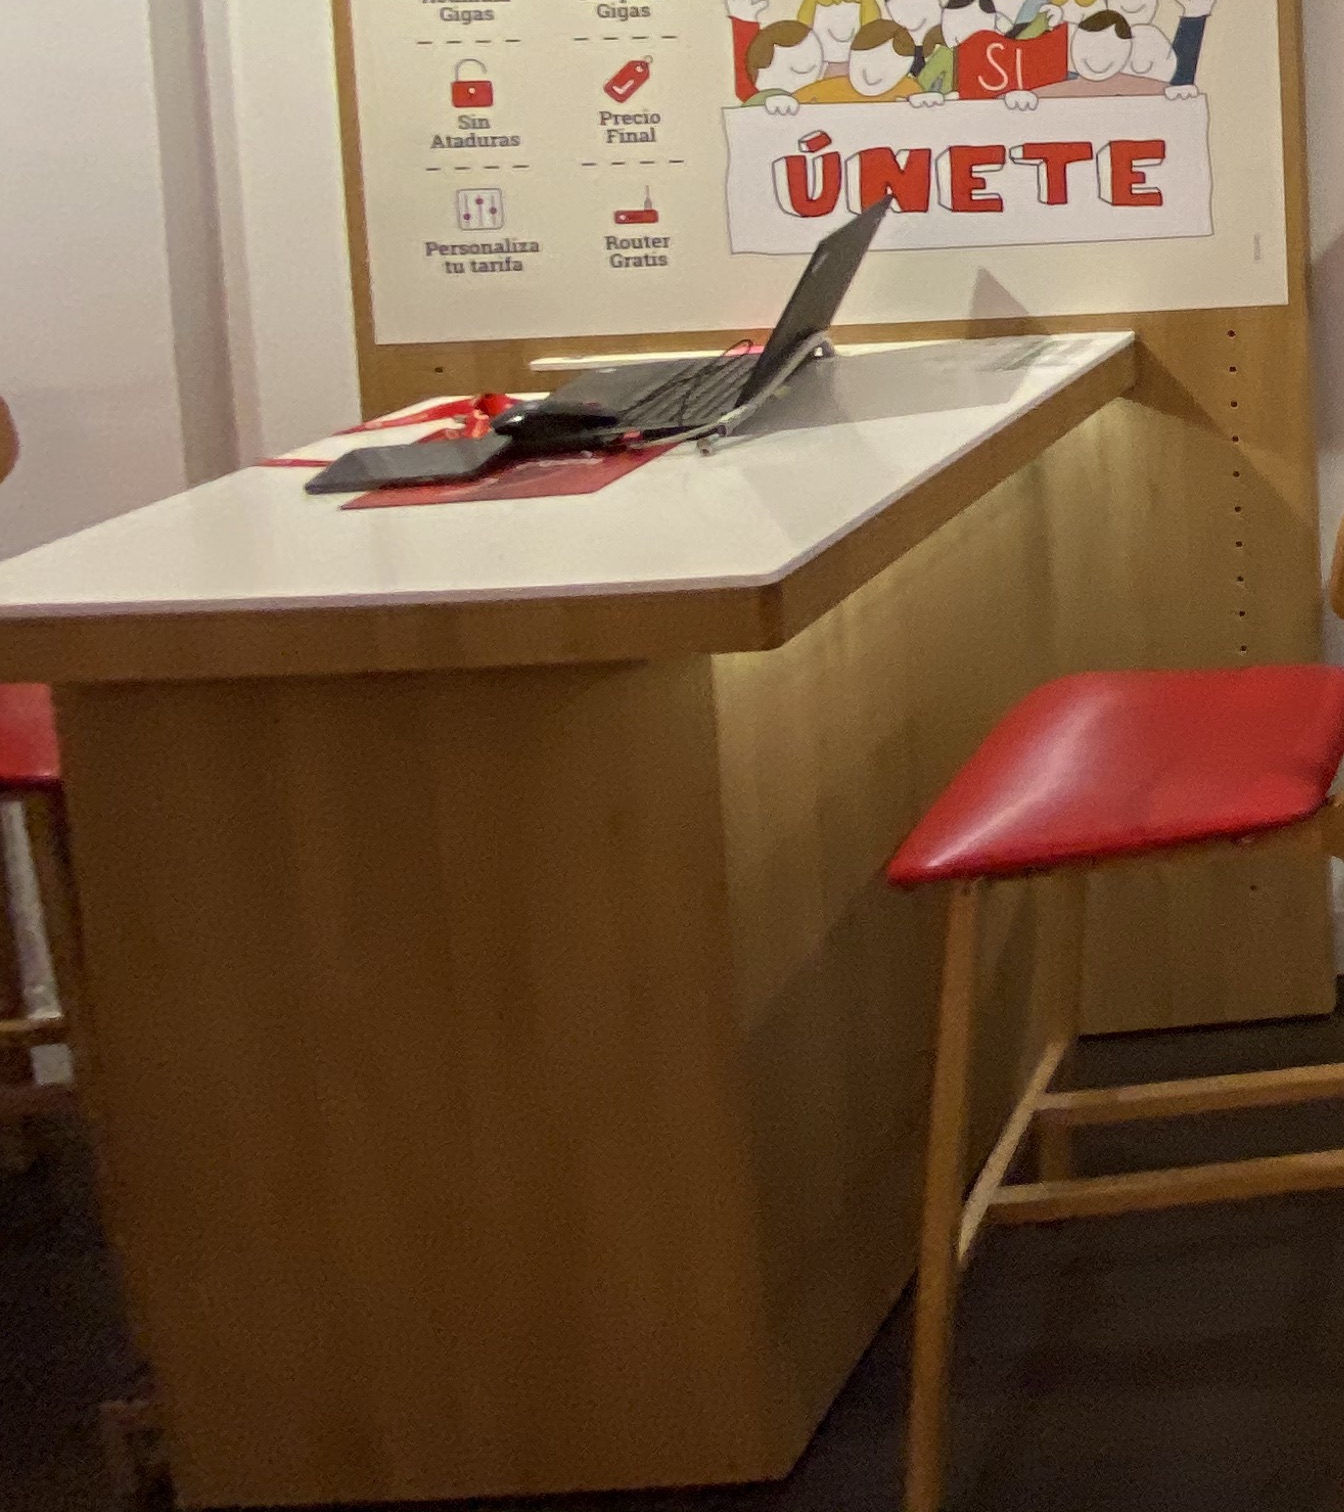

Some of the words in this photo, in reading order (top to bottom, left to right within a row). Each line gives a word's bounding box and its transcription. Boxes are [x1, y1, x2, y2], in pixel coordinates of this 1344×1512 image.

[440, 7, 495, 25] Gigas
[597, 4, 651, 21] Gigas
[458, 115, 490, 130] Sin
[599, 109, 661, 125] Precio
[431, 133, 521, 149] Ataduras
[607, 128, 656, 144] Final
[772, 130, 1166, 218] ÚNETE
[425, 239, 540, 256] Personaliza
[605, 235, 670, 250] Router
[445, 260, 465, 274] tu
[471, 257, 524, 273] tarifa
[610, 253, 668, 268] Gratis
